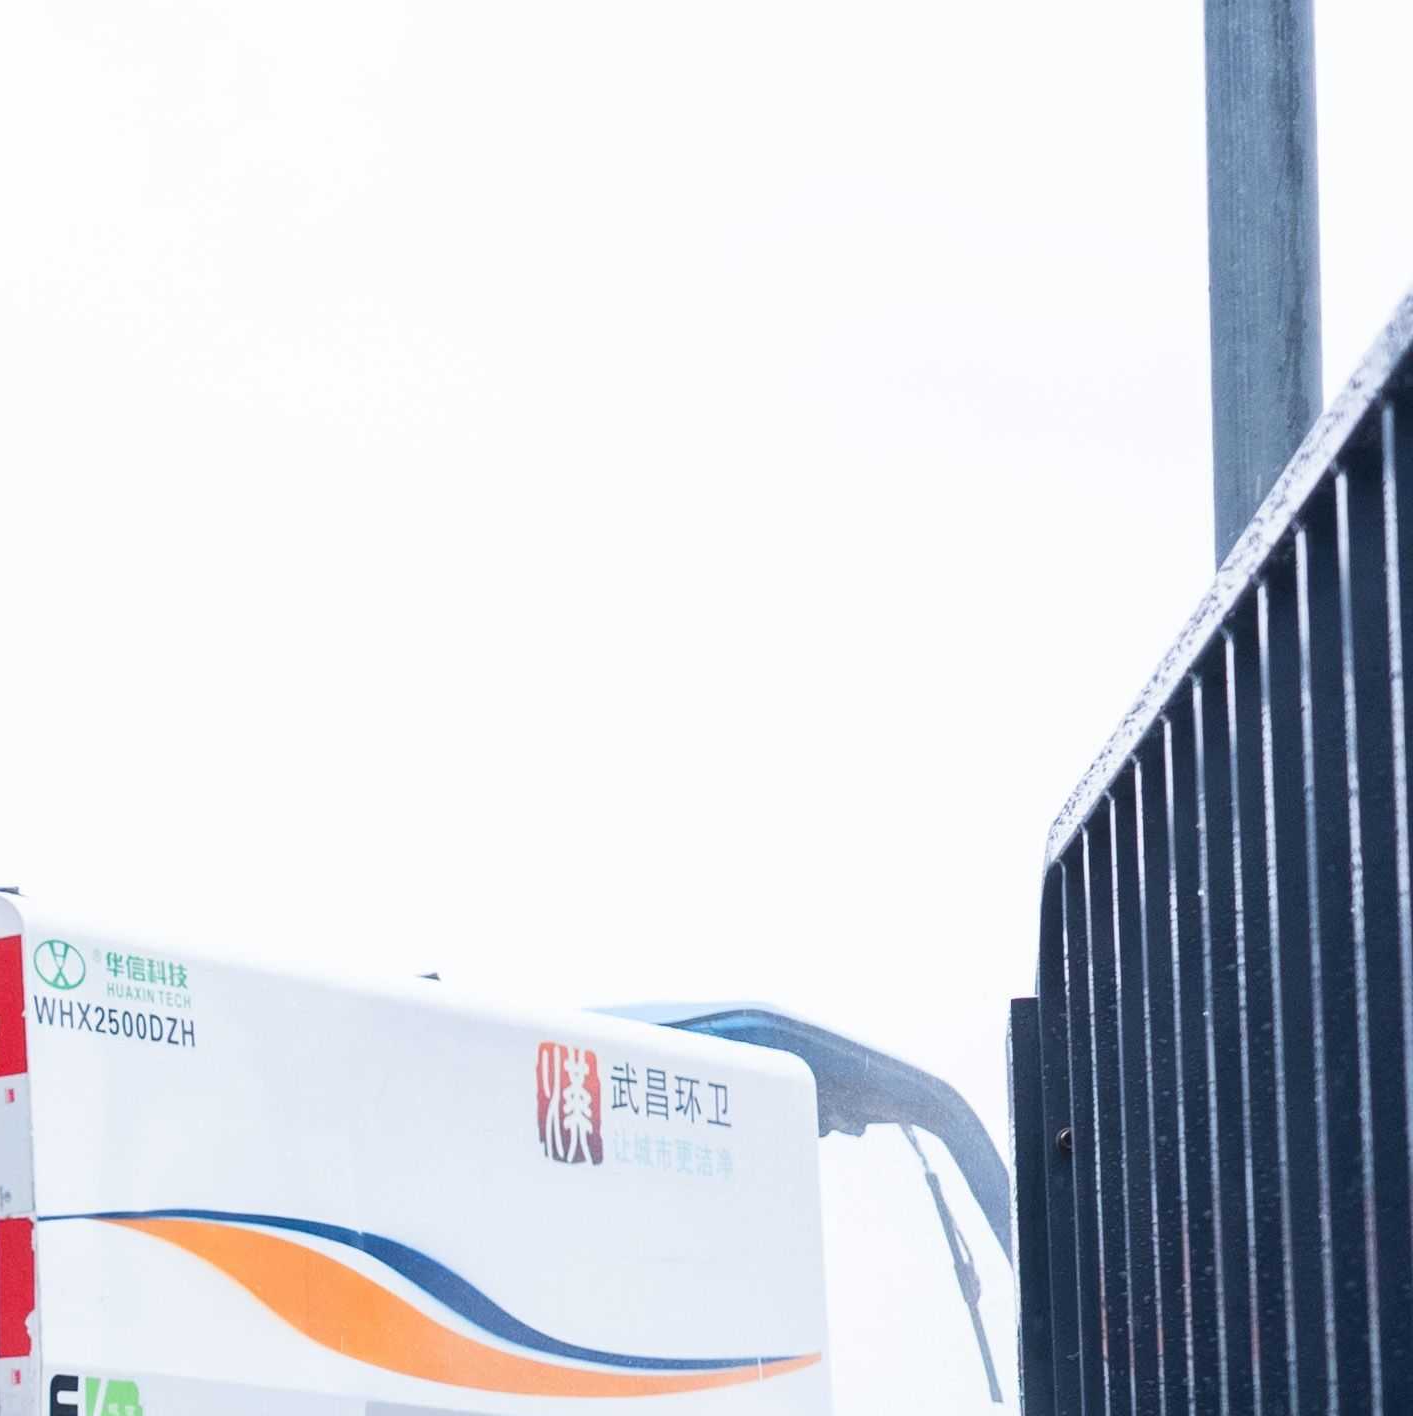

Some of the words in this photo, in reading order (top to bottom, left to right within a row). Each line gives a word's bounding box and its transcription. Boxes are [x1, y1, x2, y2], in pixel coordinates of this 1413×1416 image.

[105, 951, 189, 989] 华信科技
[106, 982, 155, 1003] HUAXIN
[158, 990, 192, 1009] TECH
[33, 994, 196, 1047] WHX2500DZH
[610, 1061, 732, 1128] 武昌环卫
